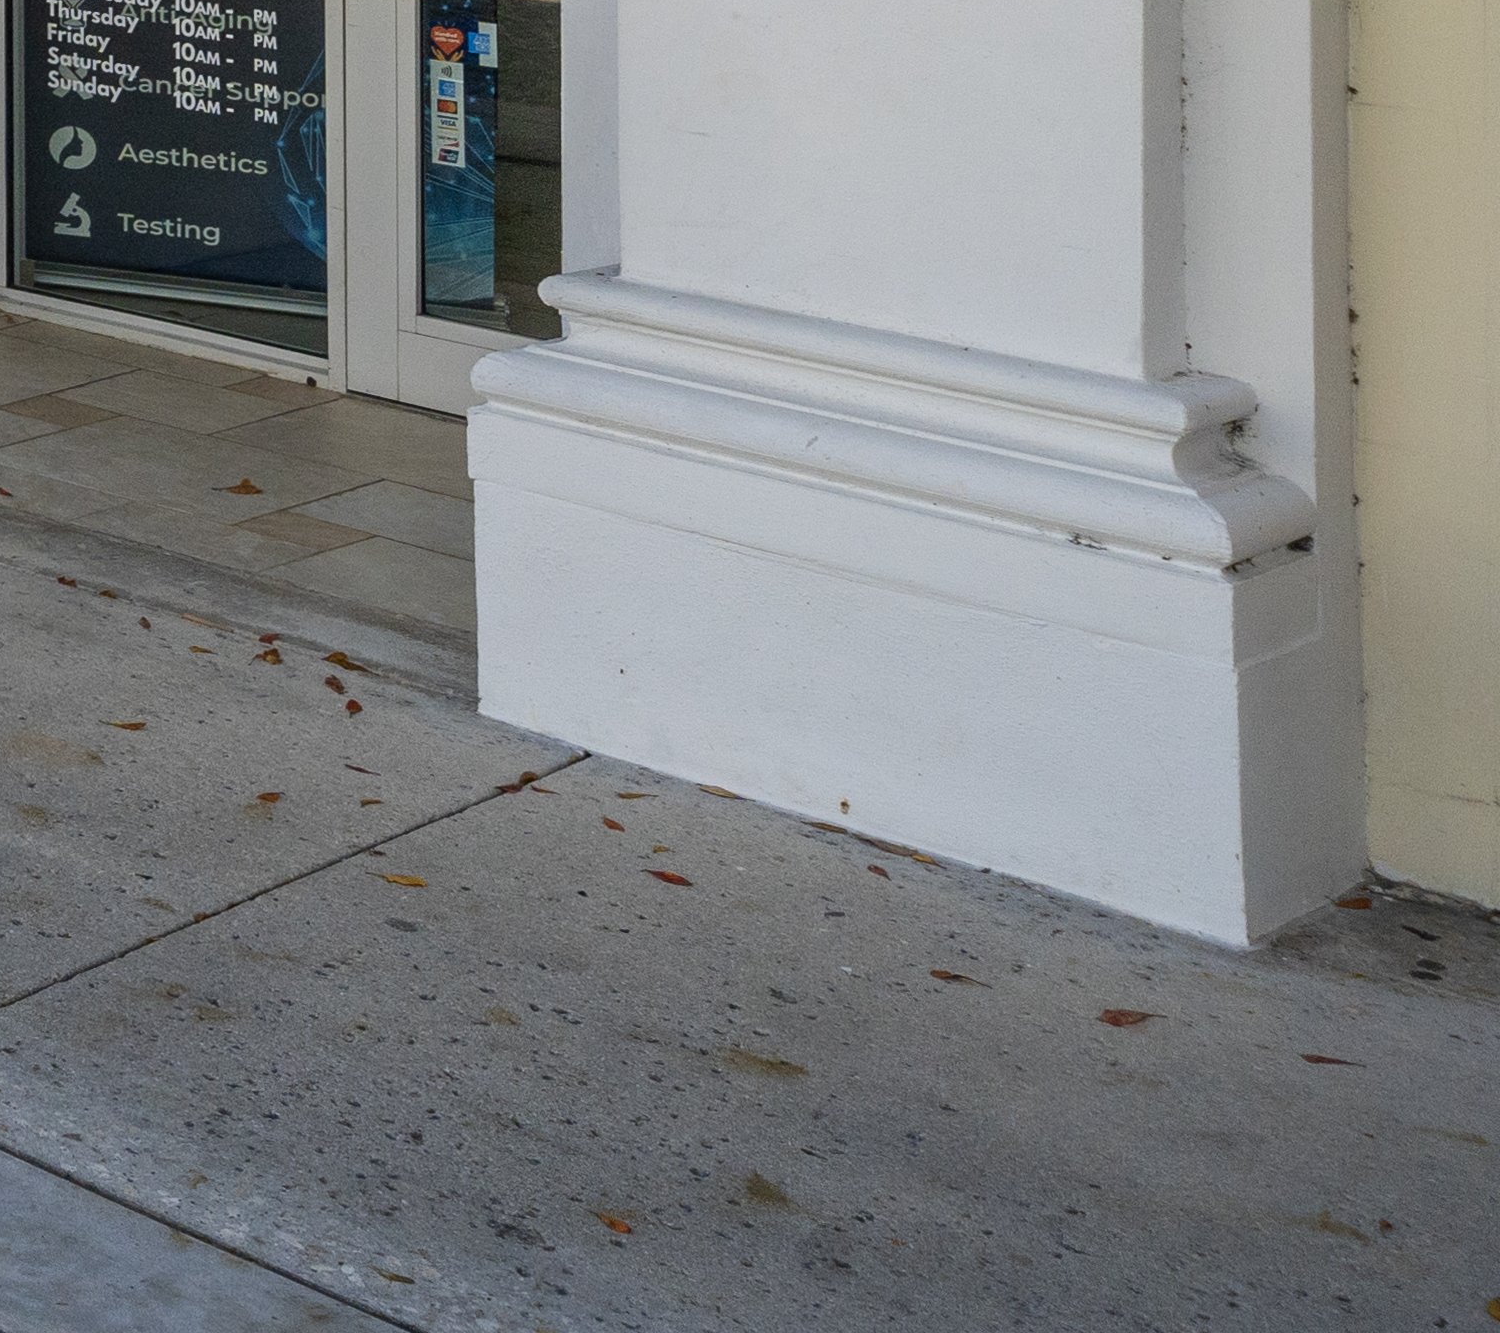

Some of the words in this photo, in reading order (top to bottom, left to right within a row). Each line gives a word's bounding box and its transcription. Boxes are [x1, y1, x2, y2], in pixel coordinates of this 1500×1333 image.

[46, 0, 140, 33] Thursday
[173, 18, 220, 42] 10AM
[253, 34, 278, 51] PM
[253, 9, 278, 26] PM
[46, 23, 111, 53] Friday
[173, 42, 221, 66] 10AM
[253, 58, 278, 75] PM
[47, 47, 140, 81] Saturday
[173, 67, 221, 91] 10AM
[254, 83, 278, 100] PM
[47, 70, 123, 103] Sunday
[173, 91, 222, 116] 10AM
[254, 108, 279, 125] PM
[440, 119, 456, 128] VISA
[117, 143, 269, 175] Aesthetics
[116, 212, 221, 247] Testing
